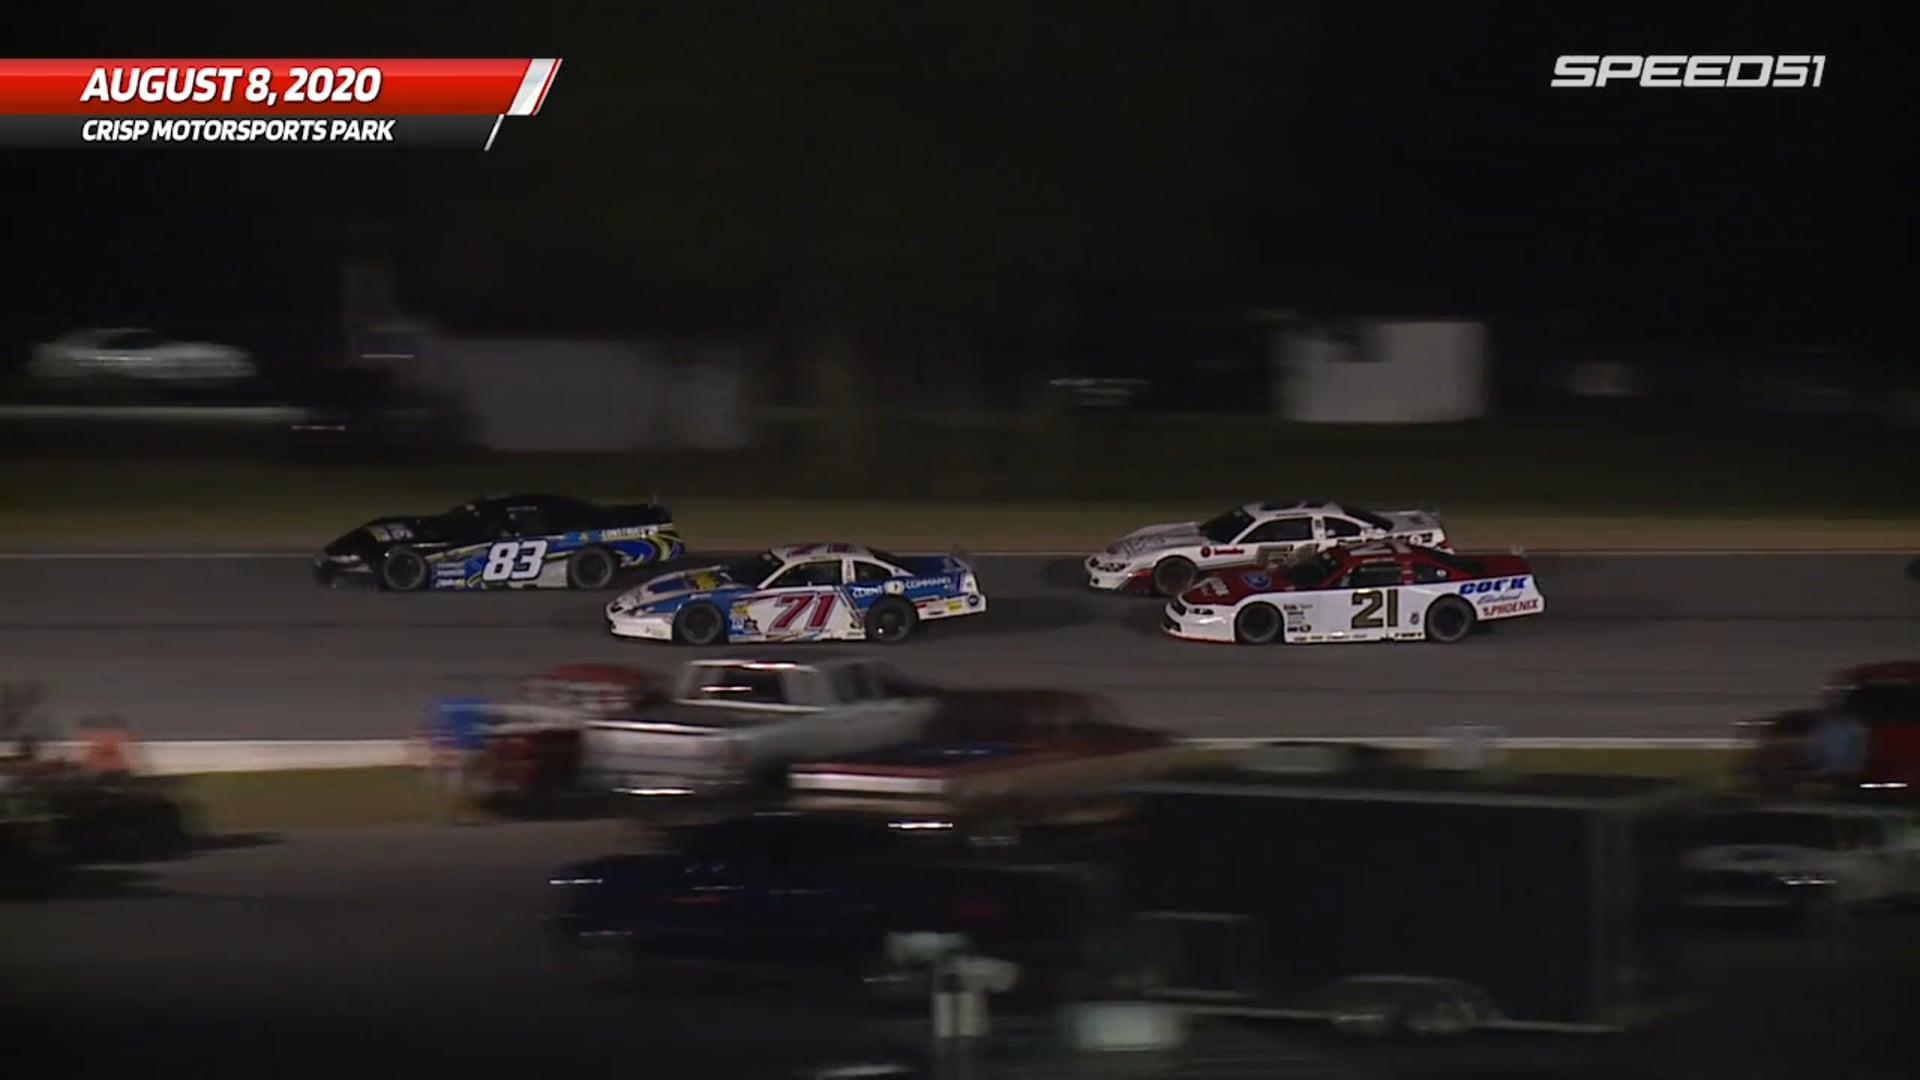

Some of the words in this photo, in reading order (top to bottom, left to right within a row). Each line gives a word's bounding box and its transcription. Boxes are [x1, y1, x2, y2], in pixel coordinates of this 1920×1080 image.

[482, 539, 548, 582] 83
[769, 591, 839, 632] 71
[1351, 588, 1399, 629] 21
